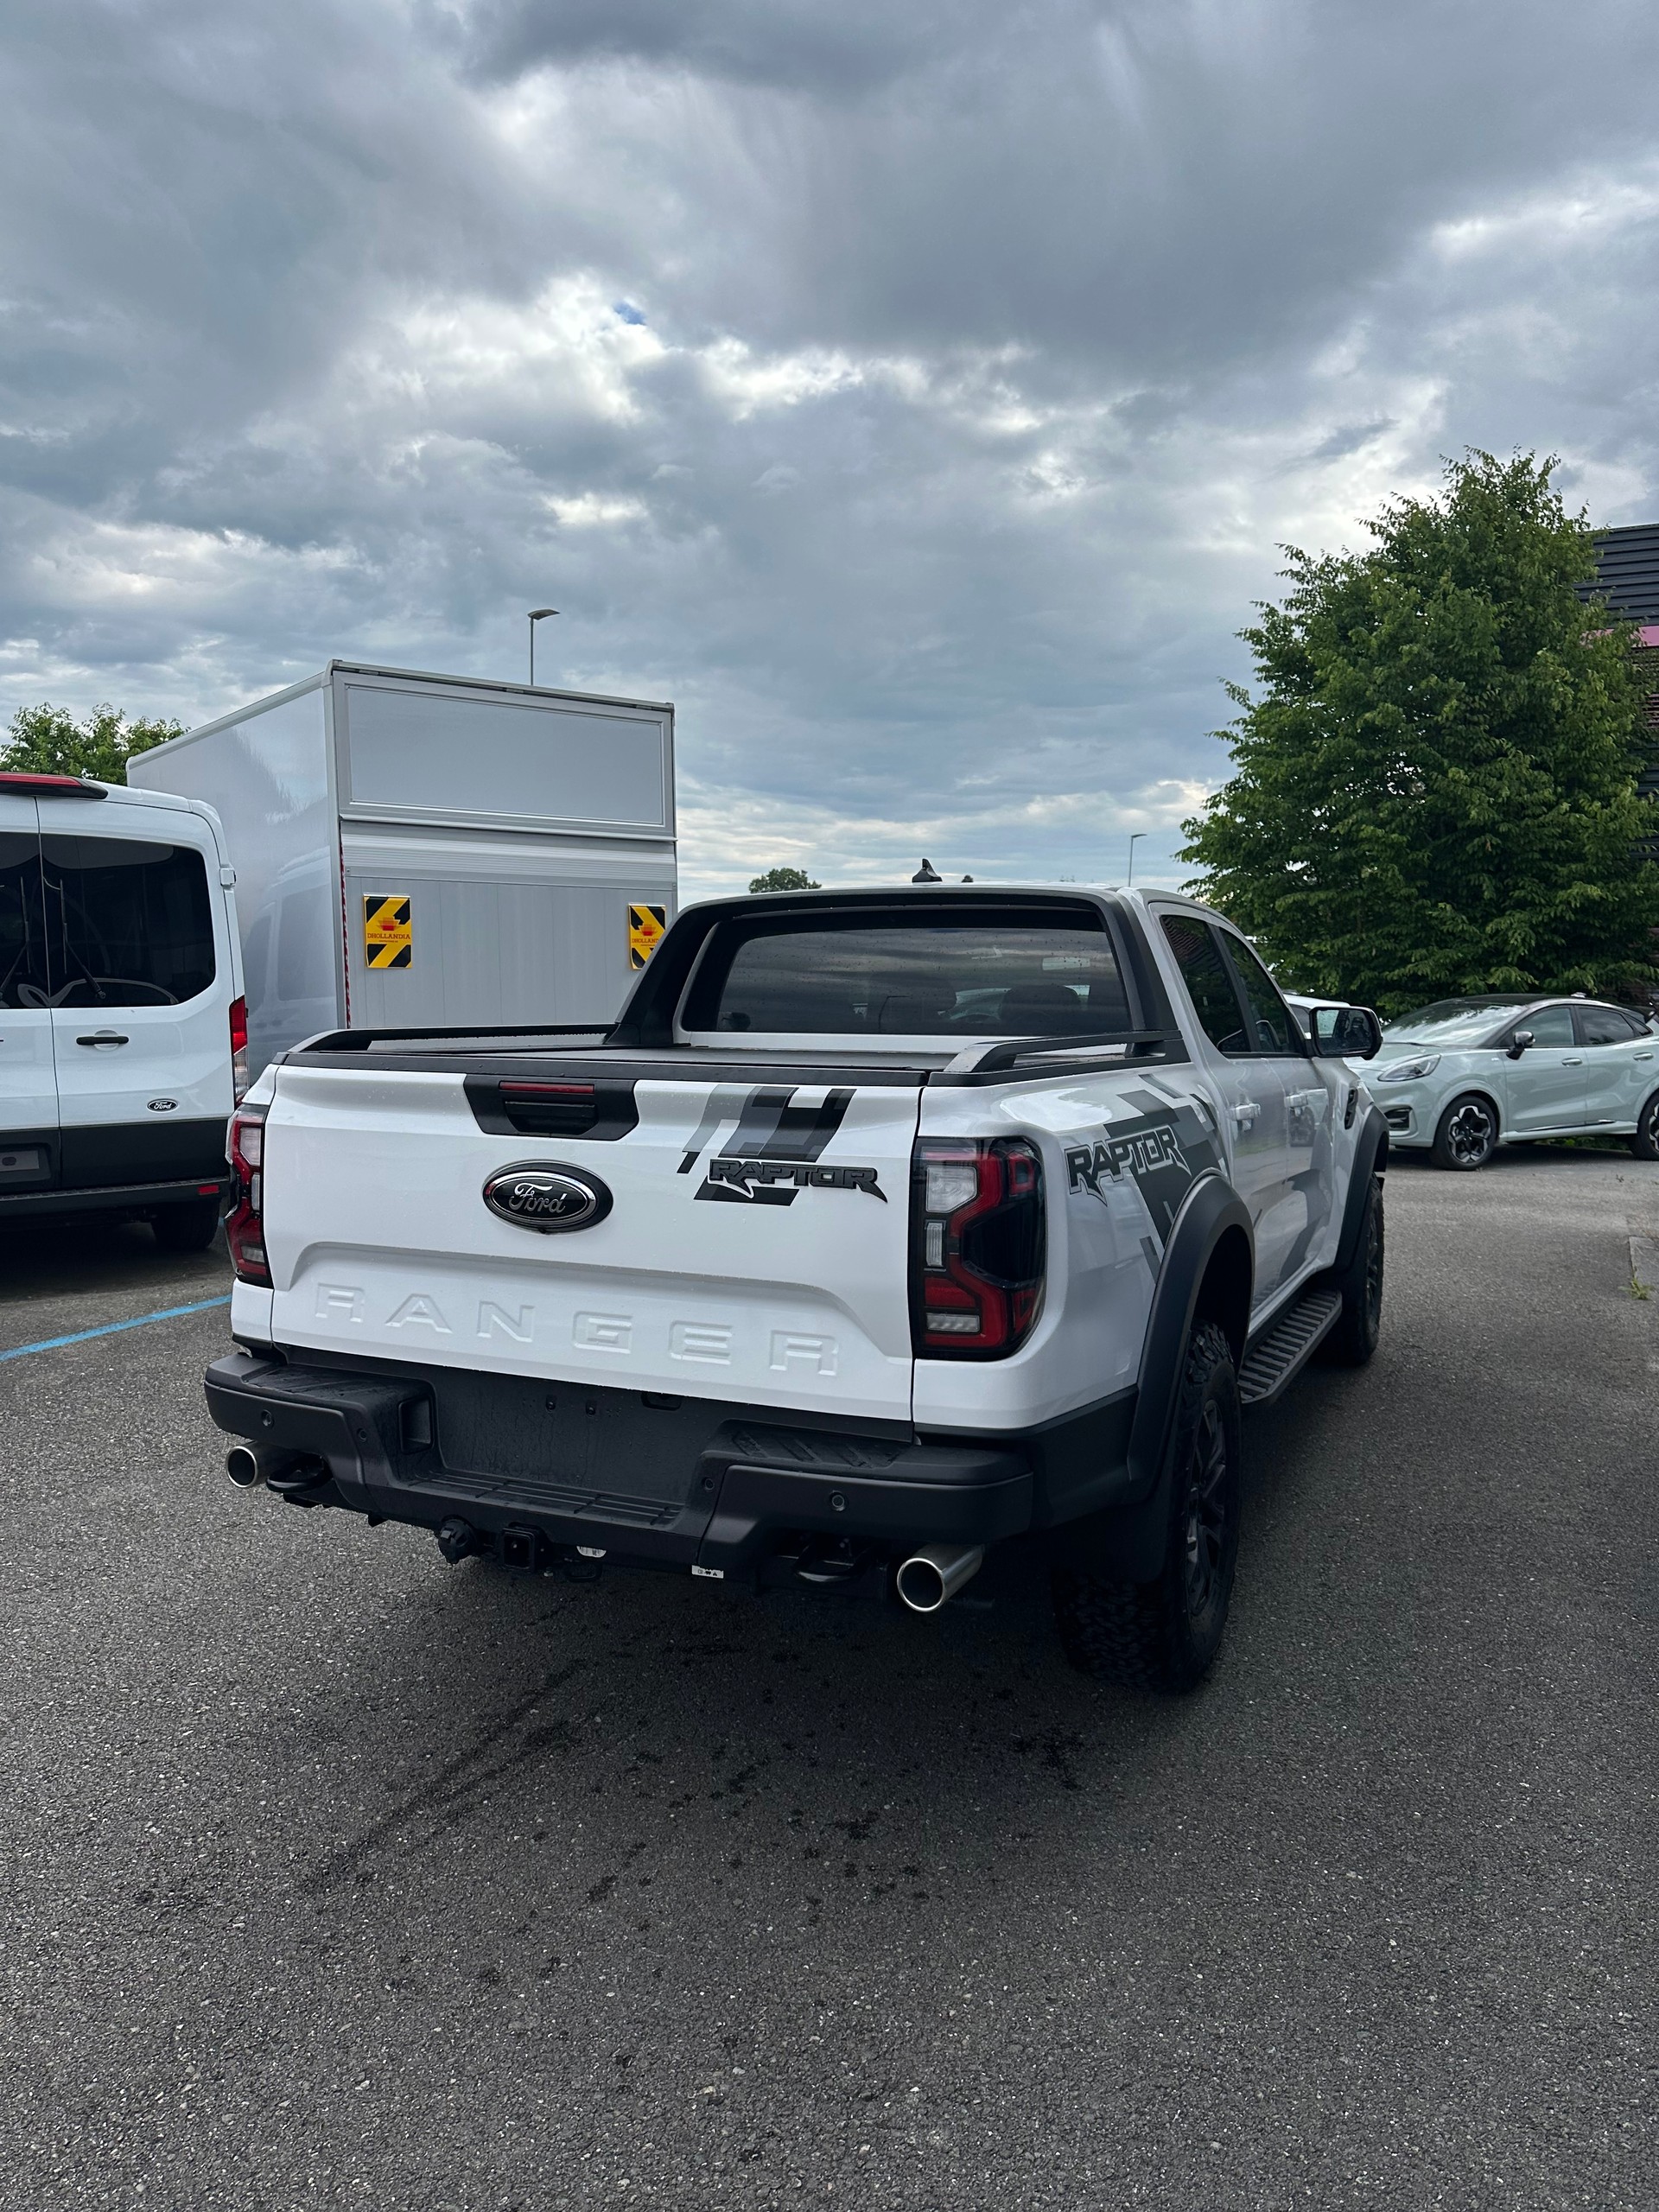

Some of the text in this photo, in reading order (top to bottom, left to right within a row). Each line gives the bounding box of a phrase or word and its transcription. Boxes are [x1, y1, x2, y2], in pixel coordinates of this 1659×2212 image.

[709, 1159, 888, 1204] RAPTOR
[1064, 1124, 1192, 1207] RAPTOR
[508, 1182, 568, 1214] Ford
[315, 1282, 839, 1376] RANGER
